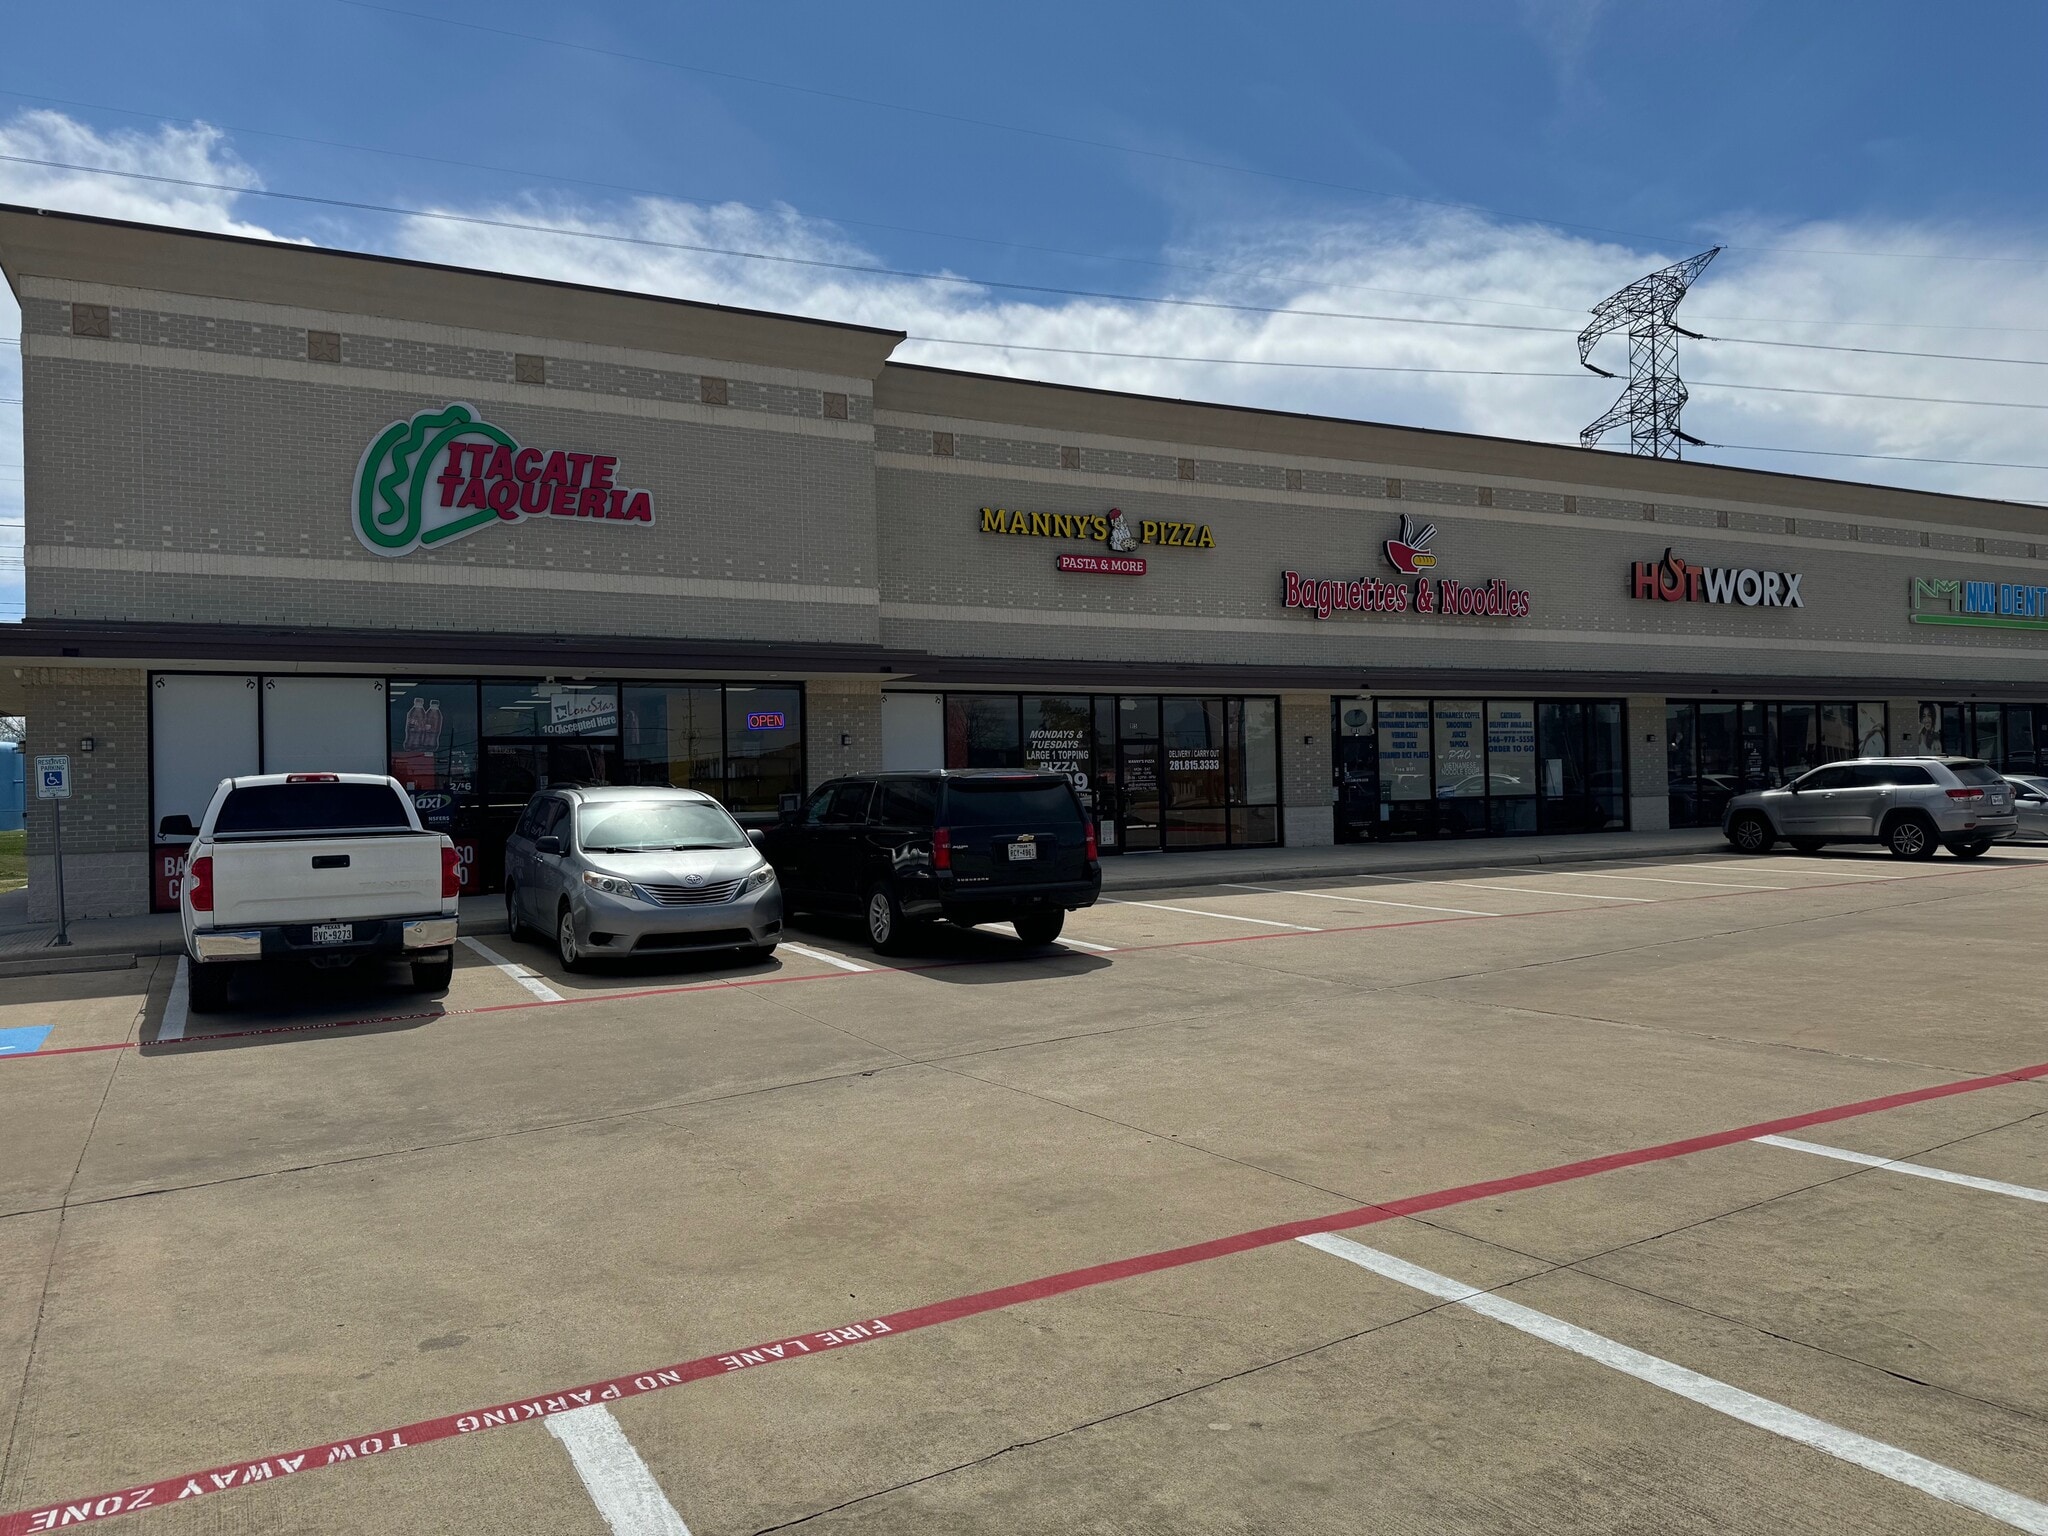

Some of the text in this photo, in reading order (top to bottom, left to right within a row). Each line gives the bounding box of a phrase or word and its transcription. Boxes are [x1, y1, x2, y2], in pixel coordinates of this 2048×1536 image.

[443, 441, 617, 490] ITACATE
[437, 476, 652, 521] TAQUERIA
[982, 507, 1216, 548] MANNY'S PIZZA
[1062, 557, 1144, 572] PASTA & MORE
[1632, 548, 1804, 608] HOTWORX
[1284, 570, 1530, 619] Baguettes & Noodles
[2001, 583, 2048, 617] DENT
[597, 715, 616, 726] Here
[750, 714, 783, 727] OPEN
[1435, 711, 1480, 719] VIETNAMESE COFFEE
[1029, 730, 1083, 739] MONDAYS &
[1032, 740, 1079, 749] TUESDAYS
[1487, 745, 1510, 753] ORDER
[1026, 750, 1089, 760] LARGE 1 TOPPING
[1168, 750, 1191, 758] DELIVERY
[1194, 750, 1209, 758] CARRY
[1210, 750, 1220, 758] OUT
[1448, 749, 1472, 760] PHO
[1040, 762, 1079, 772] PIZZA
[1169, 760, 1220, 771] 281.815.3333
[1442, 761, 1477, 769] VIETNAMESE
[1441, 768, 1464, 776] NOODLE
[455, 845, 474, 864] SO
[164, 856, 185, 877] BA
[313, 930, 351, 940] RVC-9273
[270, 1023, 338, 1033] PARKING
[26, 1319, 893, 1533] FIRE LANE NO PARKING TOW AWAY ZONE
